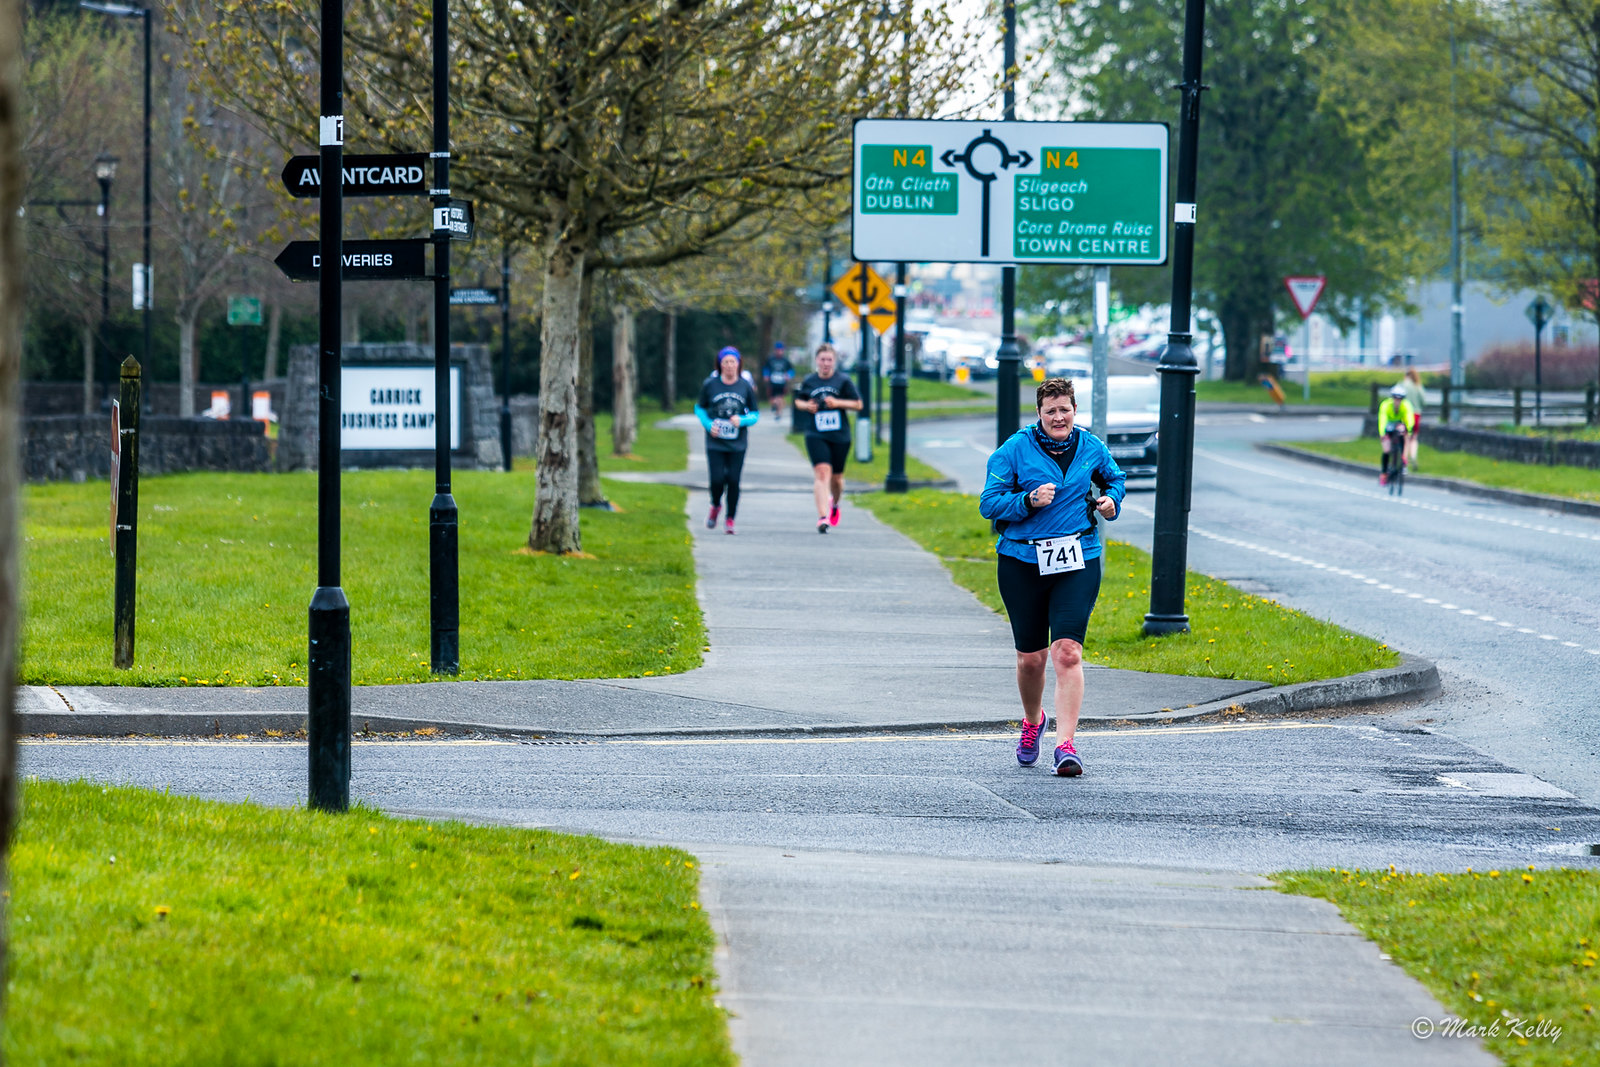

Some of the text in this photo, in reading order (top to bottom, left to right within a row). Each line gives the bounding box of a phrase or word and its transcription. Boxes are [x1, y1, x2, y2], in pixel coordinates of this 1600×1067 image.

[893, 149, 926, 167] N4
[1046, 151, 1079, 169] N4
[299, 166, 423, 185] AVNTCARD
[902, 176, 951, 191] Cliath
[1018, 178, 1088, 195] Sligeach
[866, 194, 934, 209] DUBLIN
[1019, 197, 1074, 211] SLIGO
[1018, 220, 1053, 234] Cora
[1058, 220, 1107, 235] Droma
[1018, 239, 1150, 254] TOWN CENTRE
[312, 254, 393, 267] DIVERIES
[370, 389, 421, 405] CARRICK
[342, 413, 435, 429] BUSINESS CAMP
[1042, 545, 1077, 567] 741
